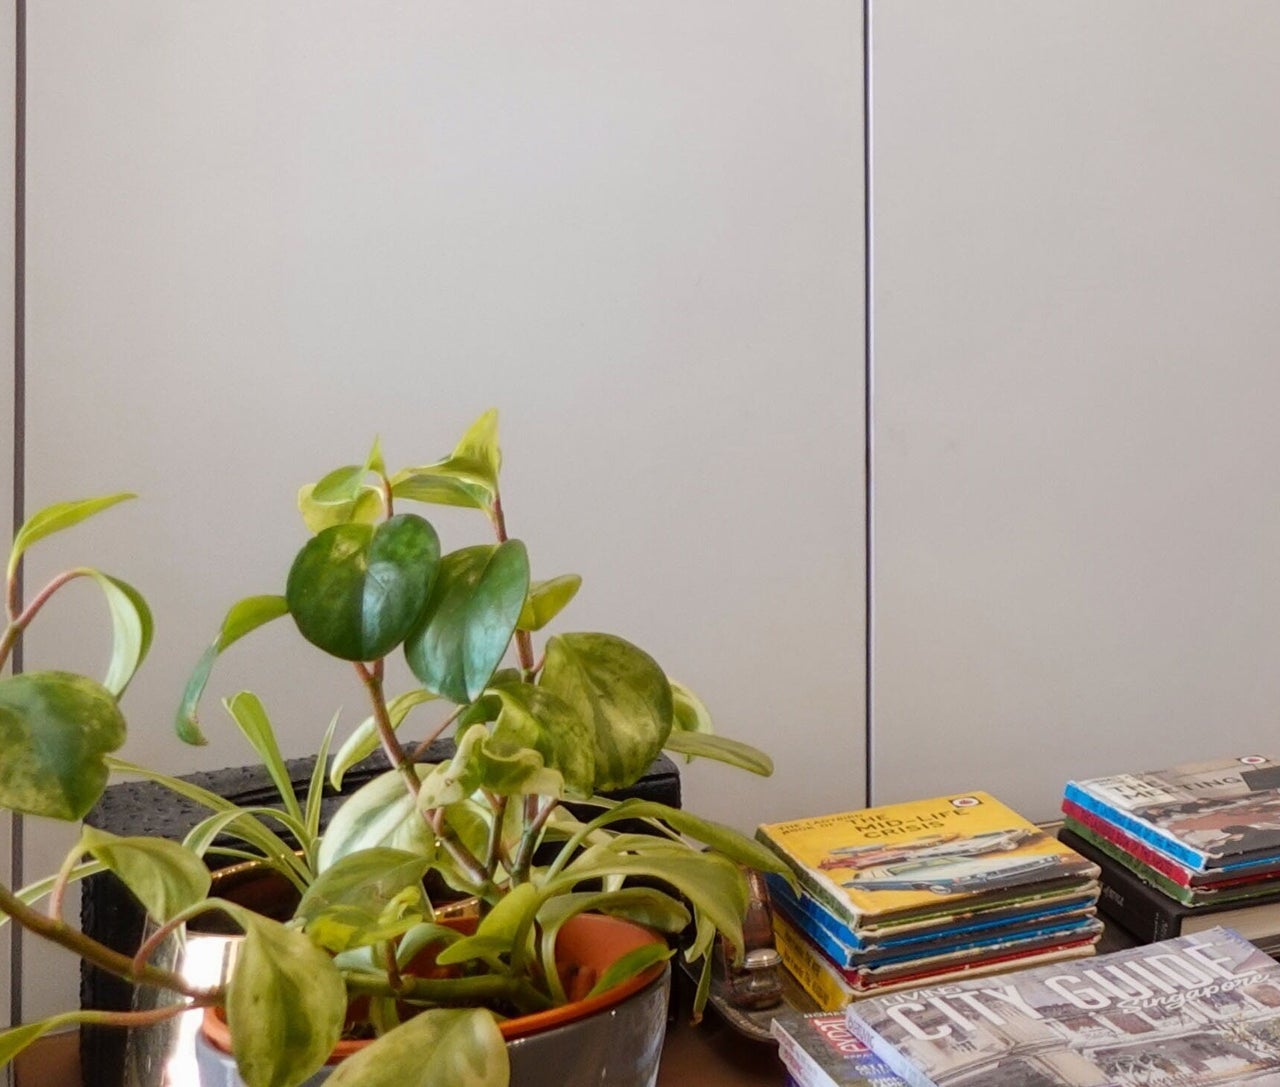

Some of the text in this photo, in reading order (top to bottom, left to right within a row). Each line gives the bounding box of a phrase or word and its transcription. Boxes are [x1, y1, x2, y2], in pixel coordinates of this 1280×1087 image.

[1106, 781, 1166, 794] THE
[1121, 776, 1243, 801] MEETING
[845, 813, 890, 825] THE
[855, 808, 971, 833] MID-LIFE
[863, 820, 946, 839] CRISIS
[879, 985, 963, 1006] LIVING
[886, 984, 1045, 1042] CITY
[1044, 942, 1258, 1010] GUIDE
[1116, 972, 1271, 1014] Singapore
